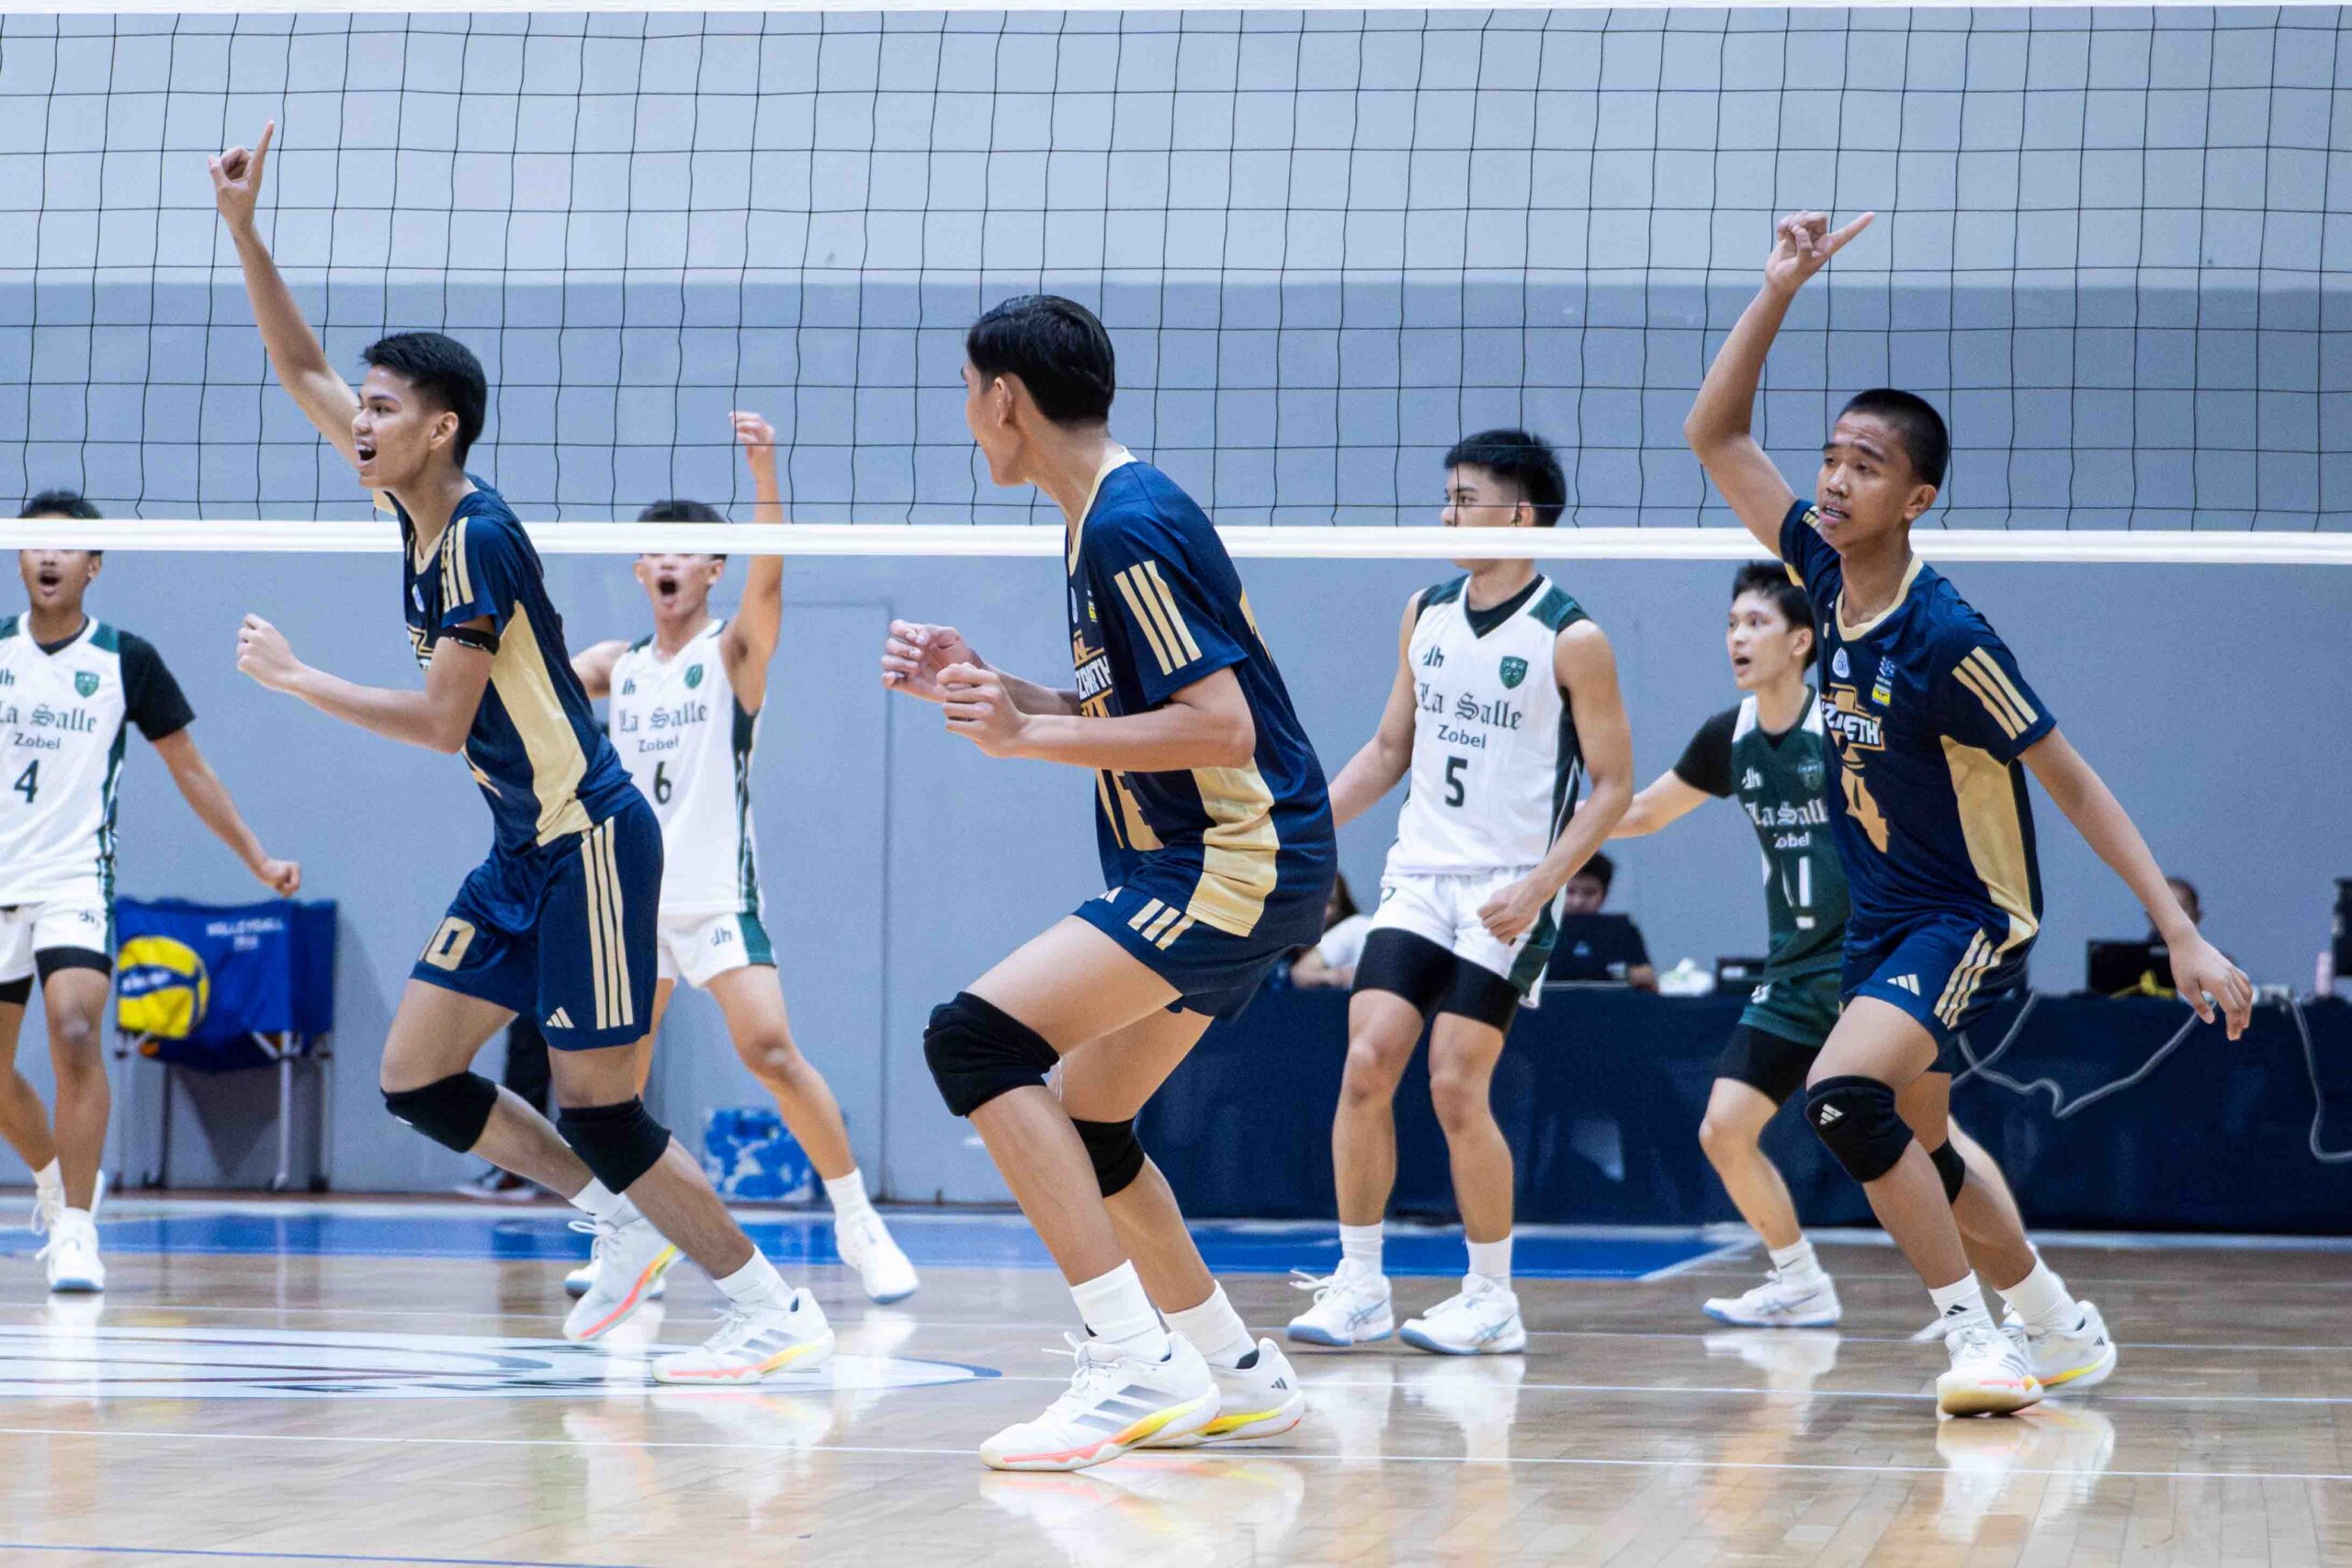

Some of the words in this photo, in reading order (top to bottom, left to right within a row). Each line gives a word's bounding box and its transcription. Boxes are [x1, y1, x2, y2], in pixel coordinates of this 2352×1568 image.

[30, 704, 98, 734] Salle
[618, 709, 639, 733] La
[649, 701, 707, 730] Salle
[1419, 682, 1443, 714] La
[1454, 692, 1522, 731] Salle
[14, 732, 61, 750] Zobel
[638, 736, 680, 753] Zobel
[1437, 724, 1487, 750] Zobel
[14, 759, 39, 805] 4
[653, 761, 672, 806] 6
[1444, 755, 1468, 808] 5
[1777, 797, 1829, 826] Sall
